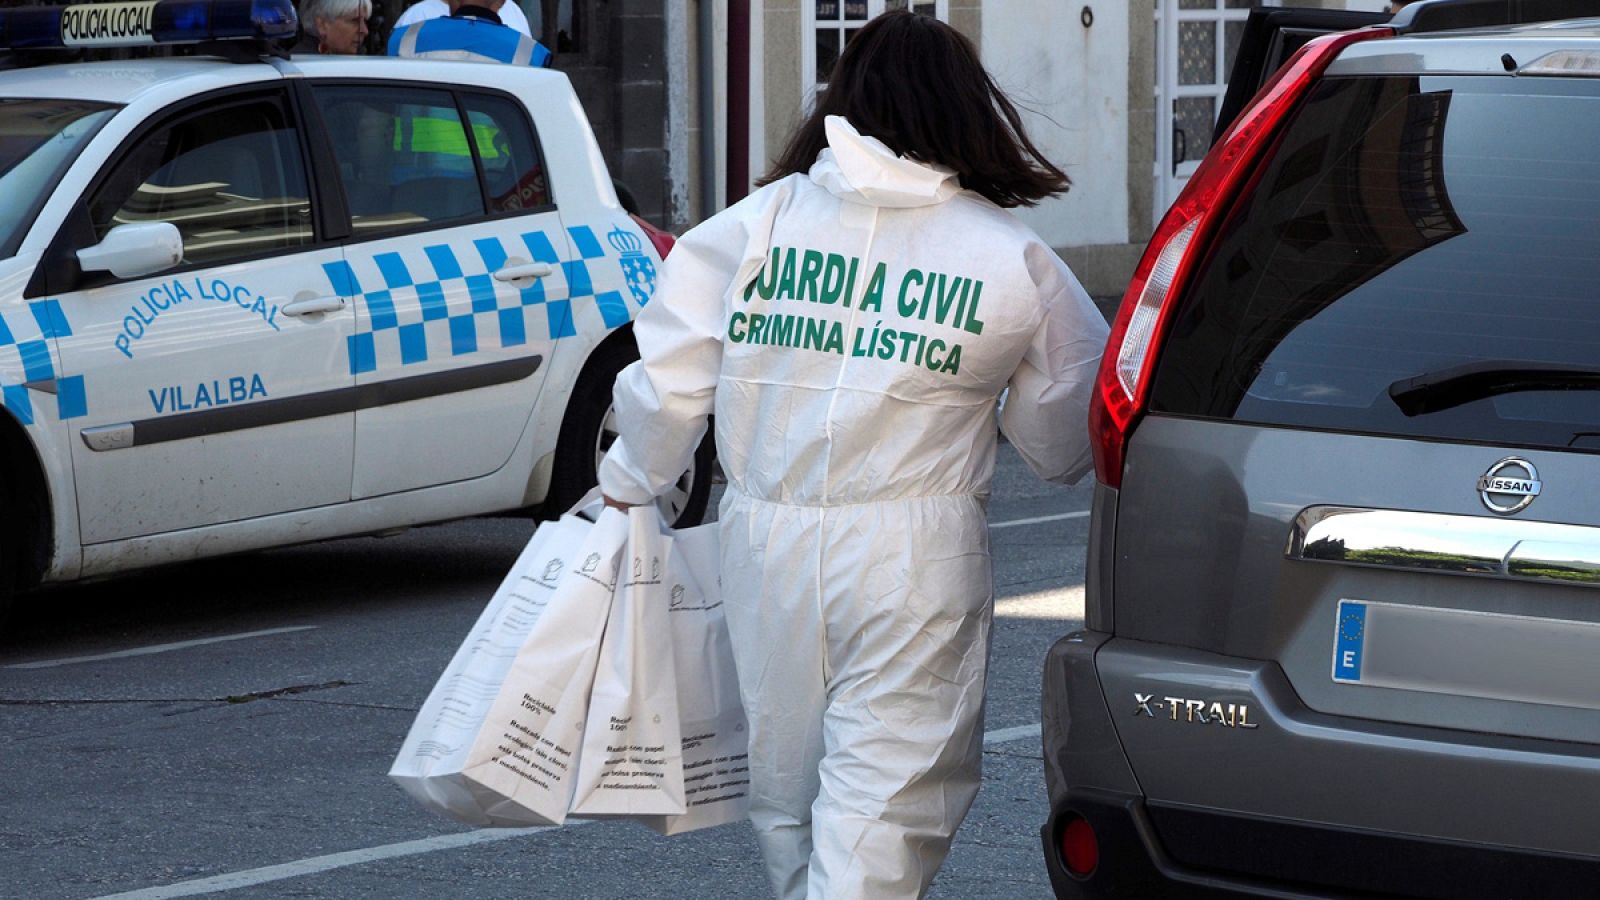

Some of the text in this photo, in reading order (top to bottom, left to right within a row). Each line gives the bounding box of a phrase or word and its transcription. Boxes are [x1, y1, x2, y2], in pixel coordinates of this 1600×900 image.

[63, 6, 152, 40] POLICIA LOCAL
[897, 268, 984, 335] CIVIL
[114, 277, 281, 359] POLICIA LOCAL
[148, 373, 268, 414] VILALBA
[1482, 479, 1533, 492] NISSAN
[1343, 650, 1356, 668] E
[520, 700, 541, 715] 100%
[523, 693, 556, 715] Reciclable
[1134, 692, 1259, 728] X-TRAIL
[540, 738, 555, 748] con
